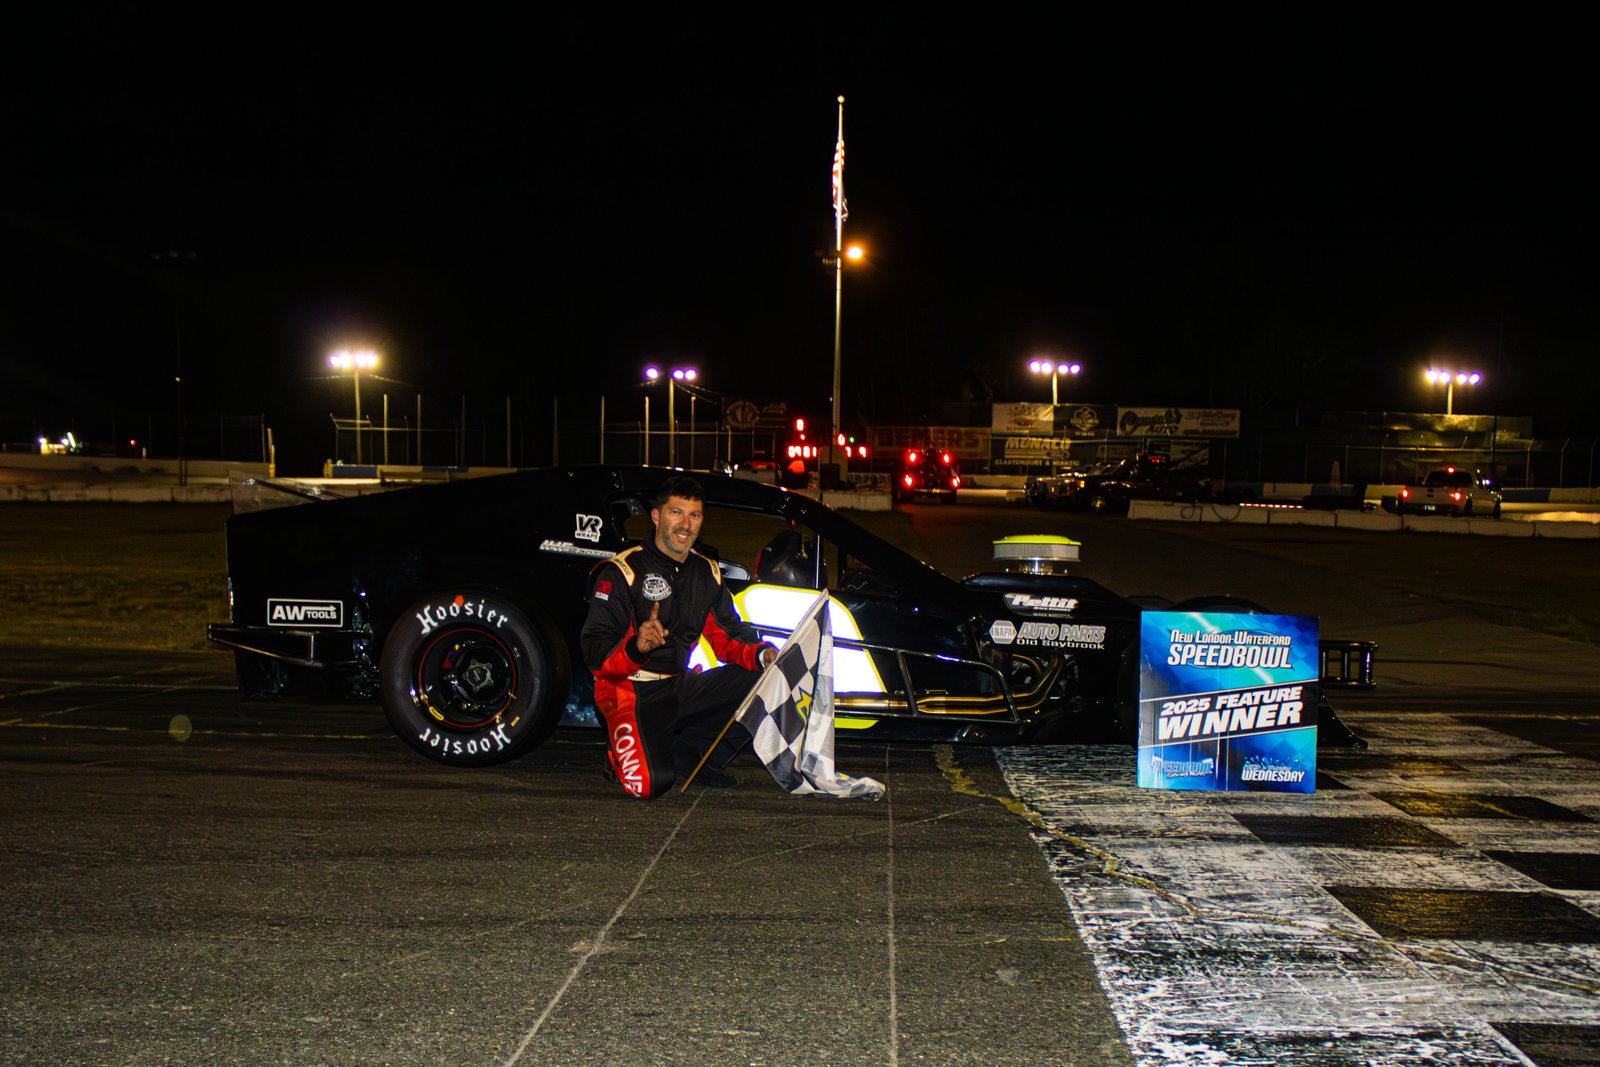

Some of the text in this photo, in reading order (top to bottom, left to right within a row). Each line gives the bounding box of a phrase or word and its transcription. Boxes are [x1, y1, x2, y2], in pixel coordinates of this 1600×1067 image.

[1005, 437, 1072, 450] MONACO
[577, 515, 601, 533] VR
[576, 531, 598, 540] WRAPS
[272, 605, 337, 620] AW TOOLS
[416, 599, 508, 635] Hoosier
[993, 621, 1106, 643] NAPA AUTO PARTS
[1016, 638, 1105, 650] Old Saybrook
[1167, 643, 1293, 669] SPEEDBOWL
[1161, 685, 1303, 716] 2025 FEATURE
[1158, 701, 1303, 740] WINNER
[419, 723, 512, 756] Hoosier
[1241, 769, 1306, 782] WEDNESDAY
